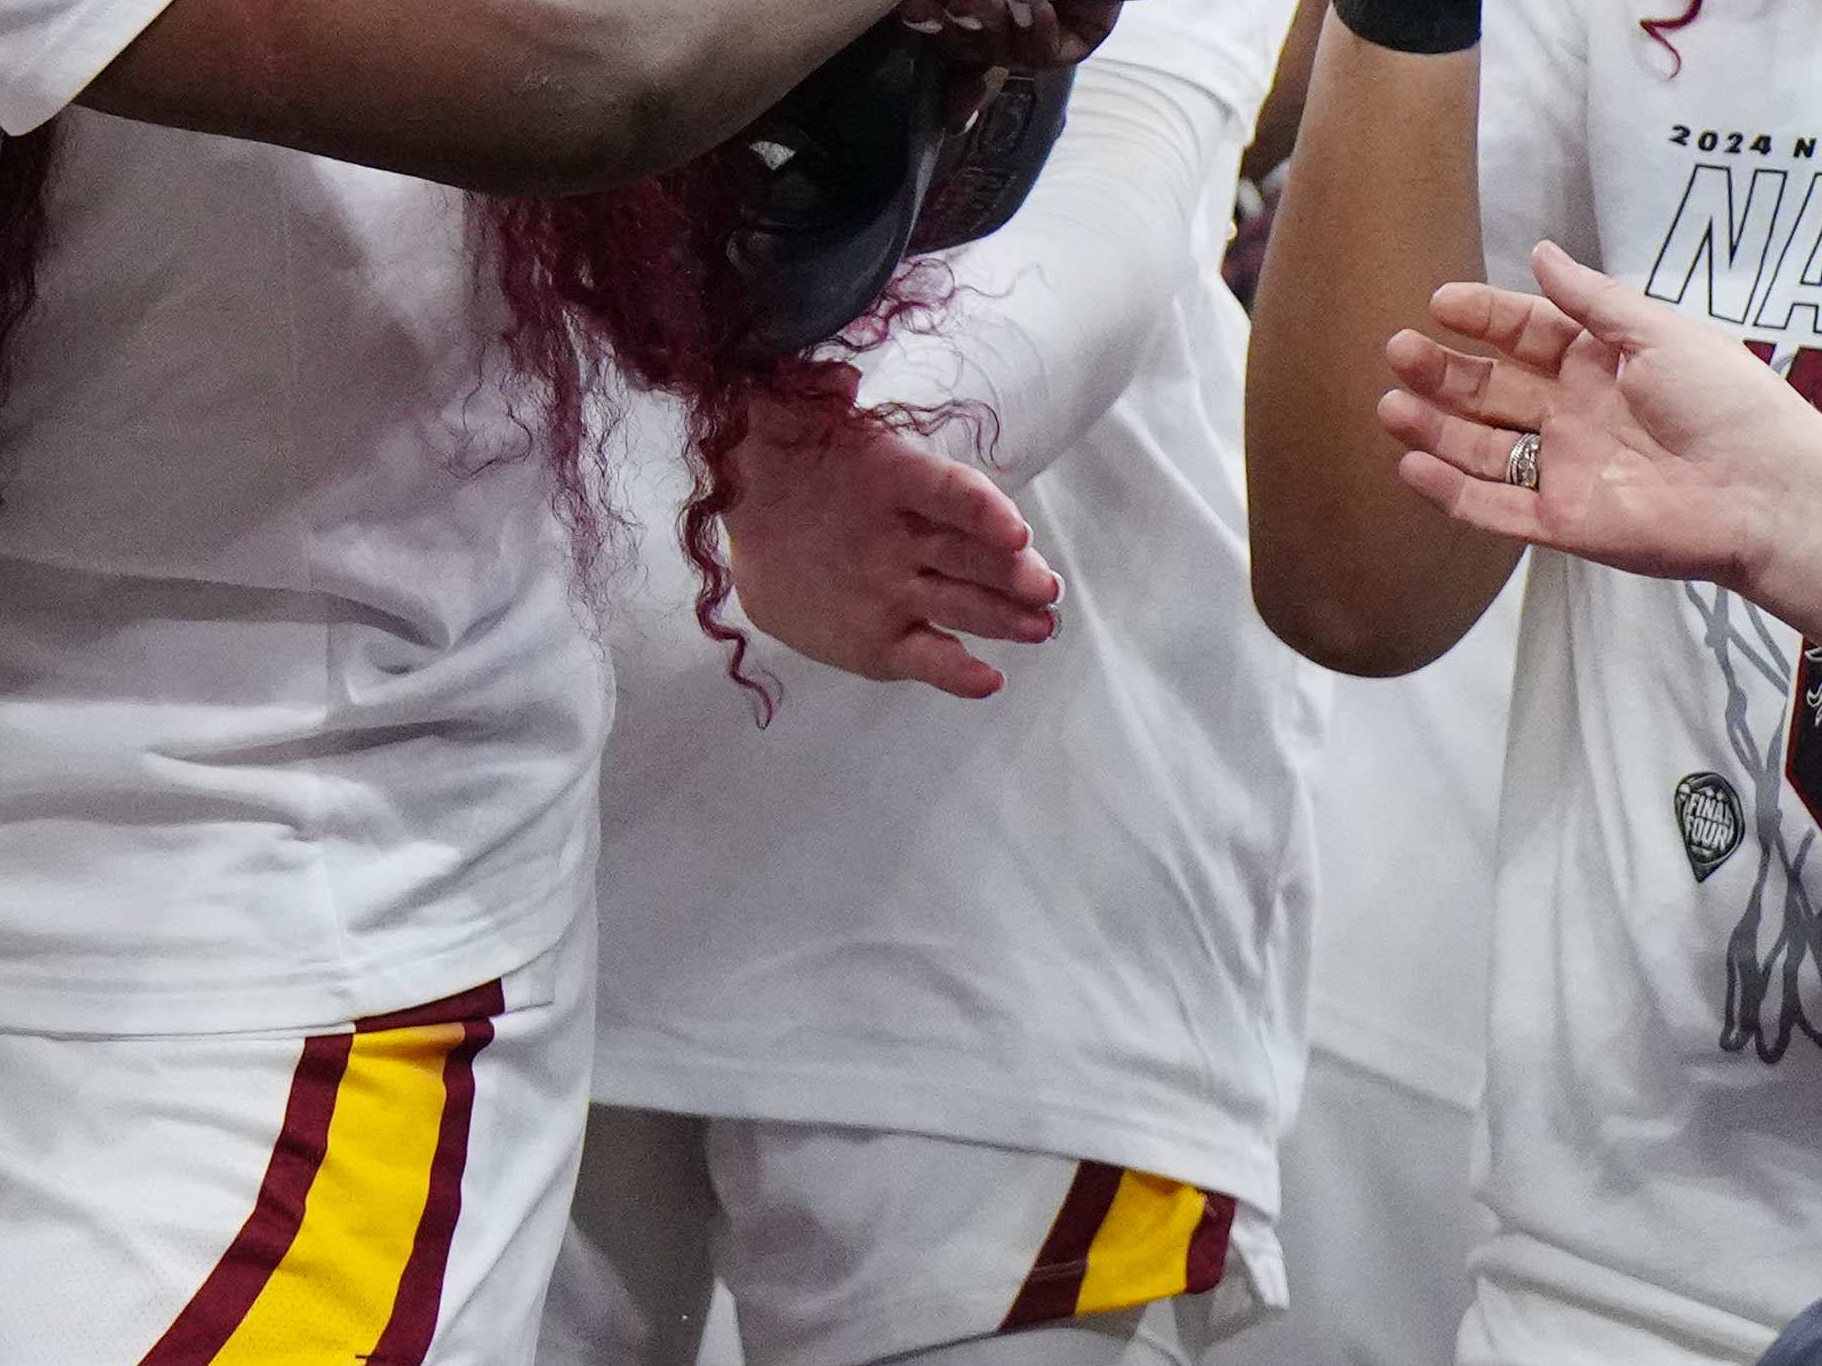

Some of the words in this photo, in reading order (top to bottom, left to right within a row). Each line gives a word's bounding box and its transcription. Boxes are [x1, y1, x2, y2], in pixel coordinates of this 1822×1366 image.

[1669, 124, 1773, 155] 2024
[1689, 793, 1733, 827] FINAL
[1687, 815, 1735, 852] FOUR
